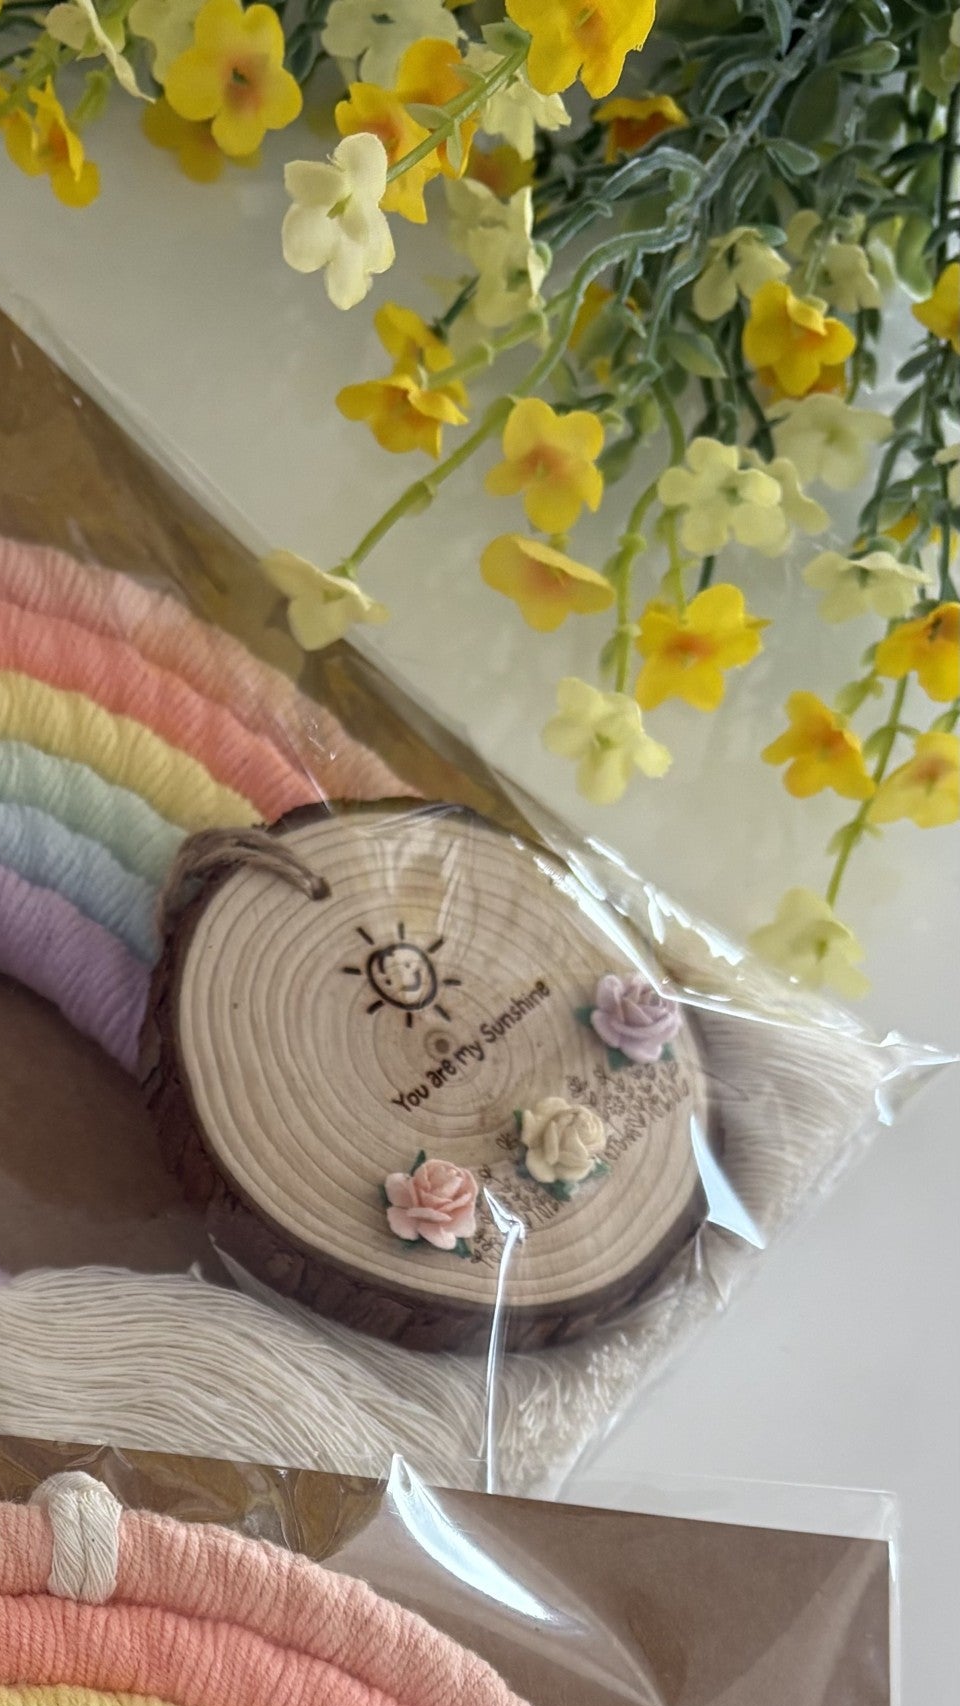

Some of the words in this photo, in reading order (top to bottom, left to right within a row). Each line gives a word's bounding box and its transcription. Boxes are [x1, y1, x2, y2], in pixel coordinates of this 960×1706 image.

[391, 1083, 429, 1113] You
[425, 1058, 457, 1089] are
[456, 1038, 485, 1070] my
[480, 981, 552, 1044] Sunshine
